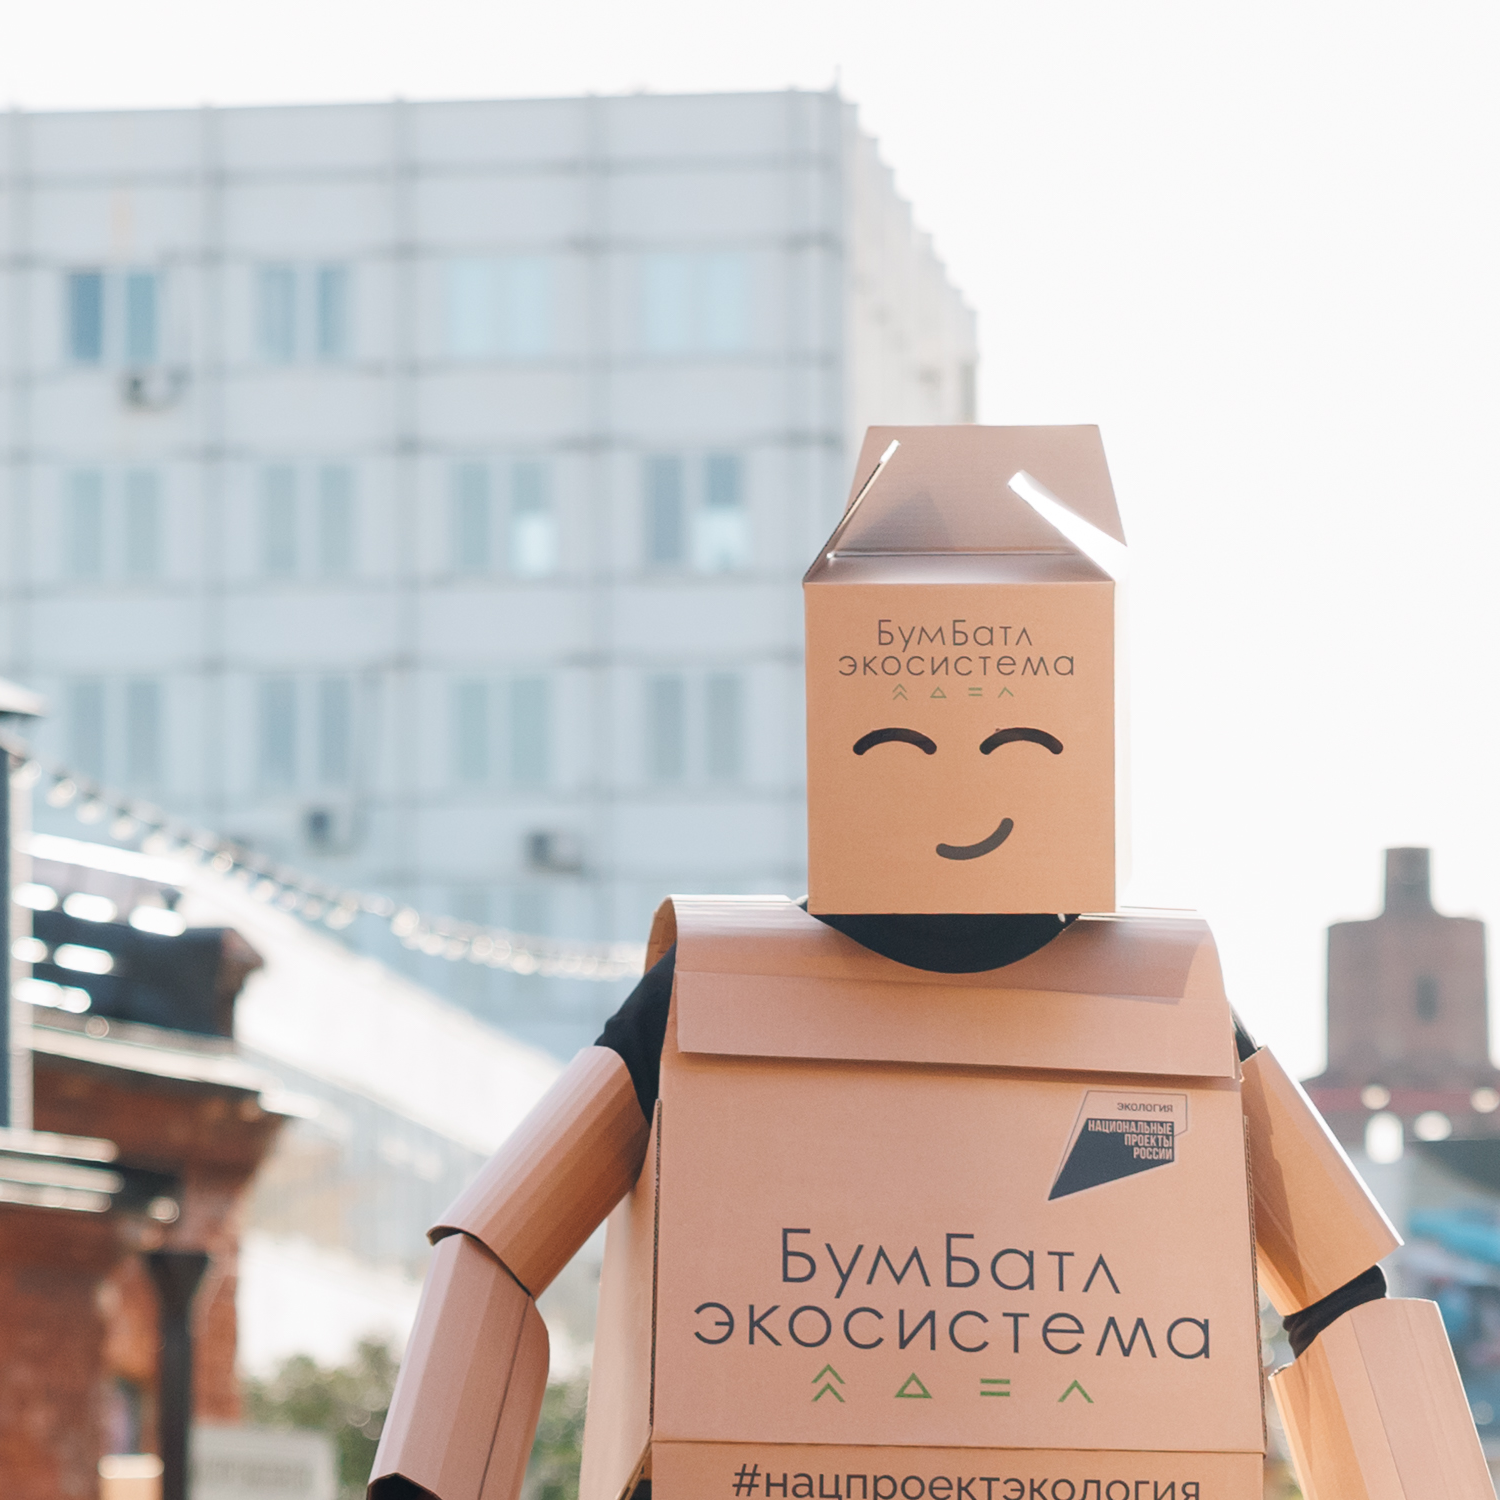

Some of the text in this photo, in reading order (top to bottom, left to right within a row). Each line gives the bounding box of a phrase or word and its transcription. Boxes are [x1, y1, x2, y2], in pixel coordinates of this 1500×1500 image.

[878, 619, 1033, 652] БумБатл
[838, 655, 1074, 676] экосистема
[1117, 1102, 1173, 1112] ЭКОЛОГИЯ
[1088, 1119, 1173, 1135] НАЦИОНАЛЬНЫЕ
[1124, 1134, 1173, 1147] ПРОЕКТЫ
[1133, 1147, 1173, 1160] РОССИИ
[782, 1228, 1120, 1298] БумБатл
[694, 1302, 1210, 1359] экосистема
